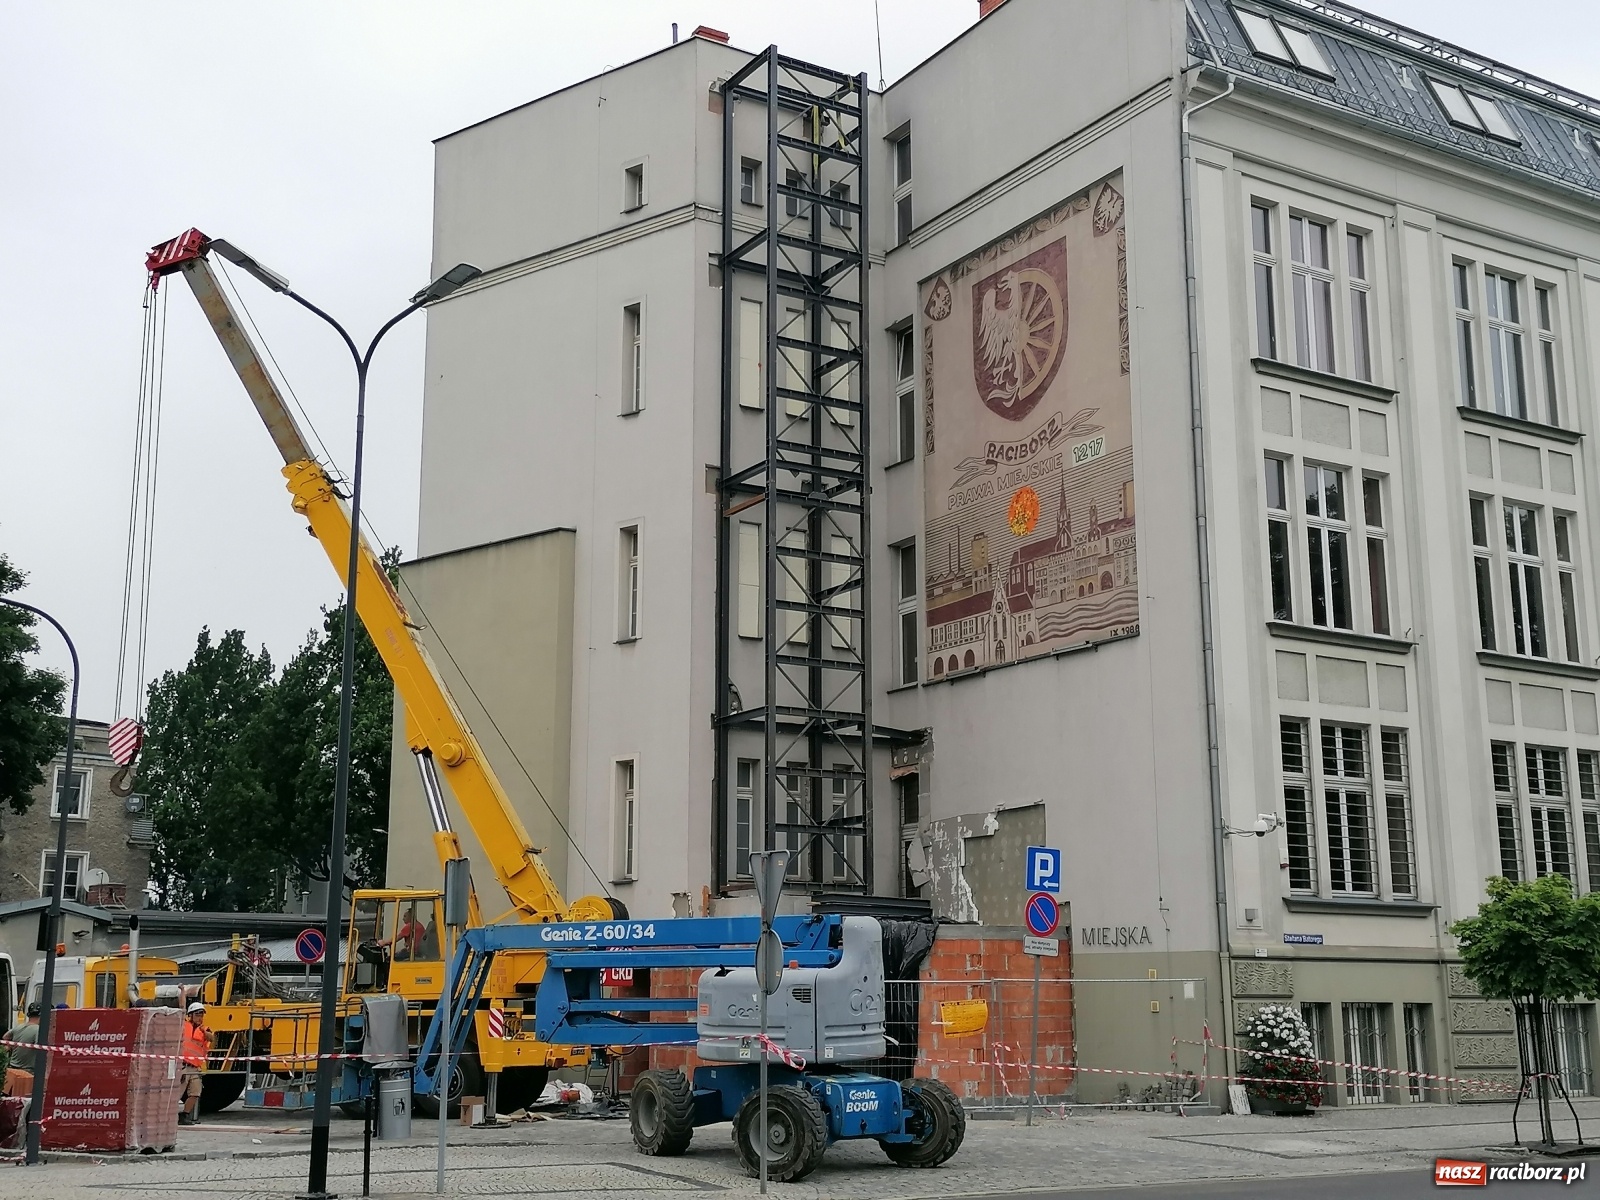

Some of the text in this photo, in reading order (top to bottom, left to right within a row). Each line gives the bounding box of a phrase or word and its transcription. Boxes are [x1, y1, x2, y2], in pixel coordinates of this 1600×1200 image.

[947, 437, 1104, 510] PRAWA MIEJSKIE 1217
[1110, 628, 1119, 637] IX
[1034, 852, 1054, 886] P
[541, 923, 656, 942] Genie Z-60/34
[1081, 926, 1153, 947] MIEJSKA
[64, 1031, 127, 1042] Wienerberger
[849, 1089, 877, 1100] Genie
[54, 1096, 119, 1107] Wienerberger
[846, 1100, 879, 1113] BOOM
[53, 1108, 120, 1119] Porotherm
